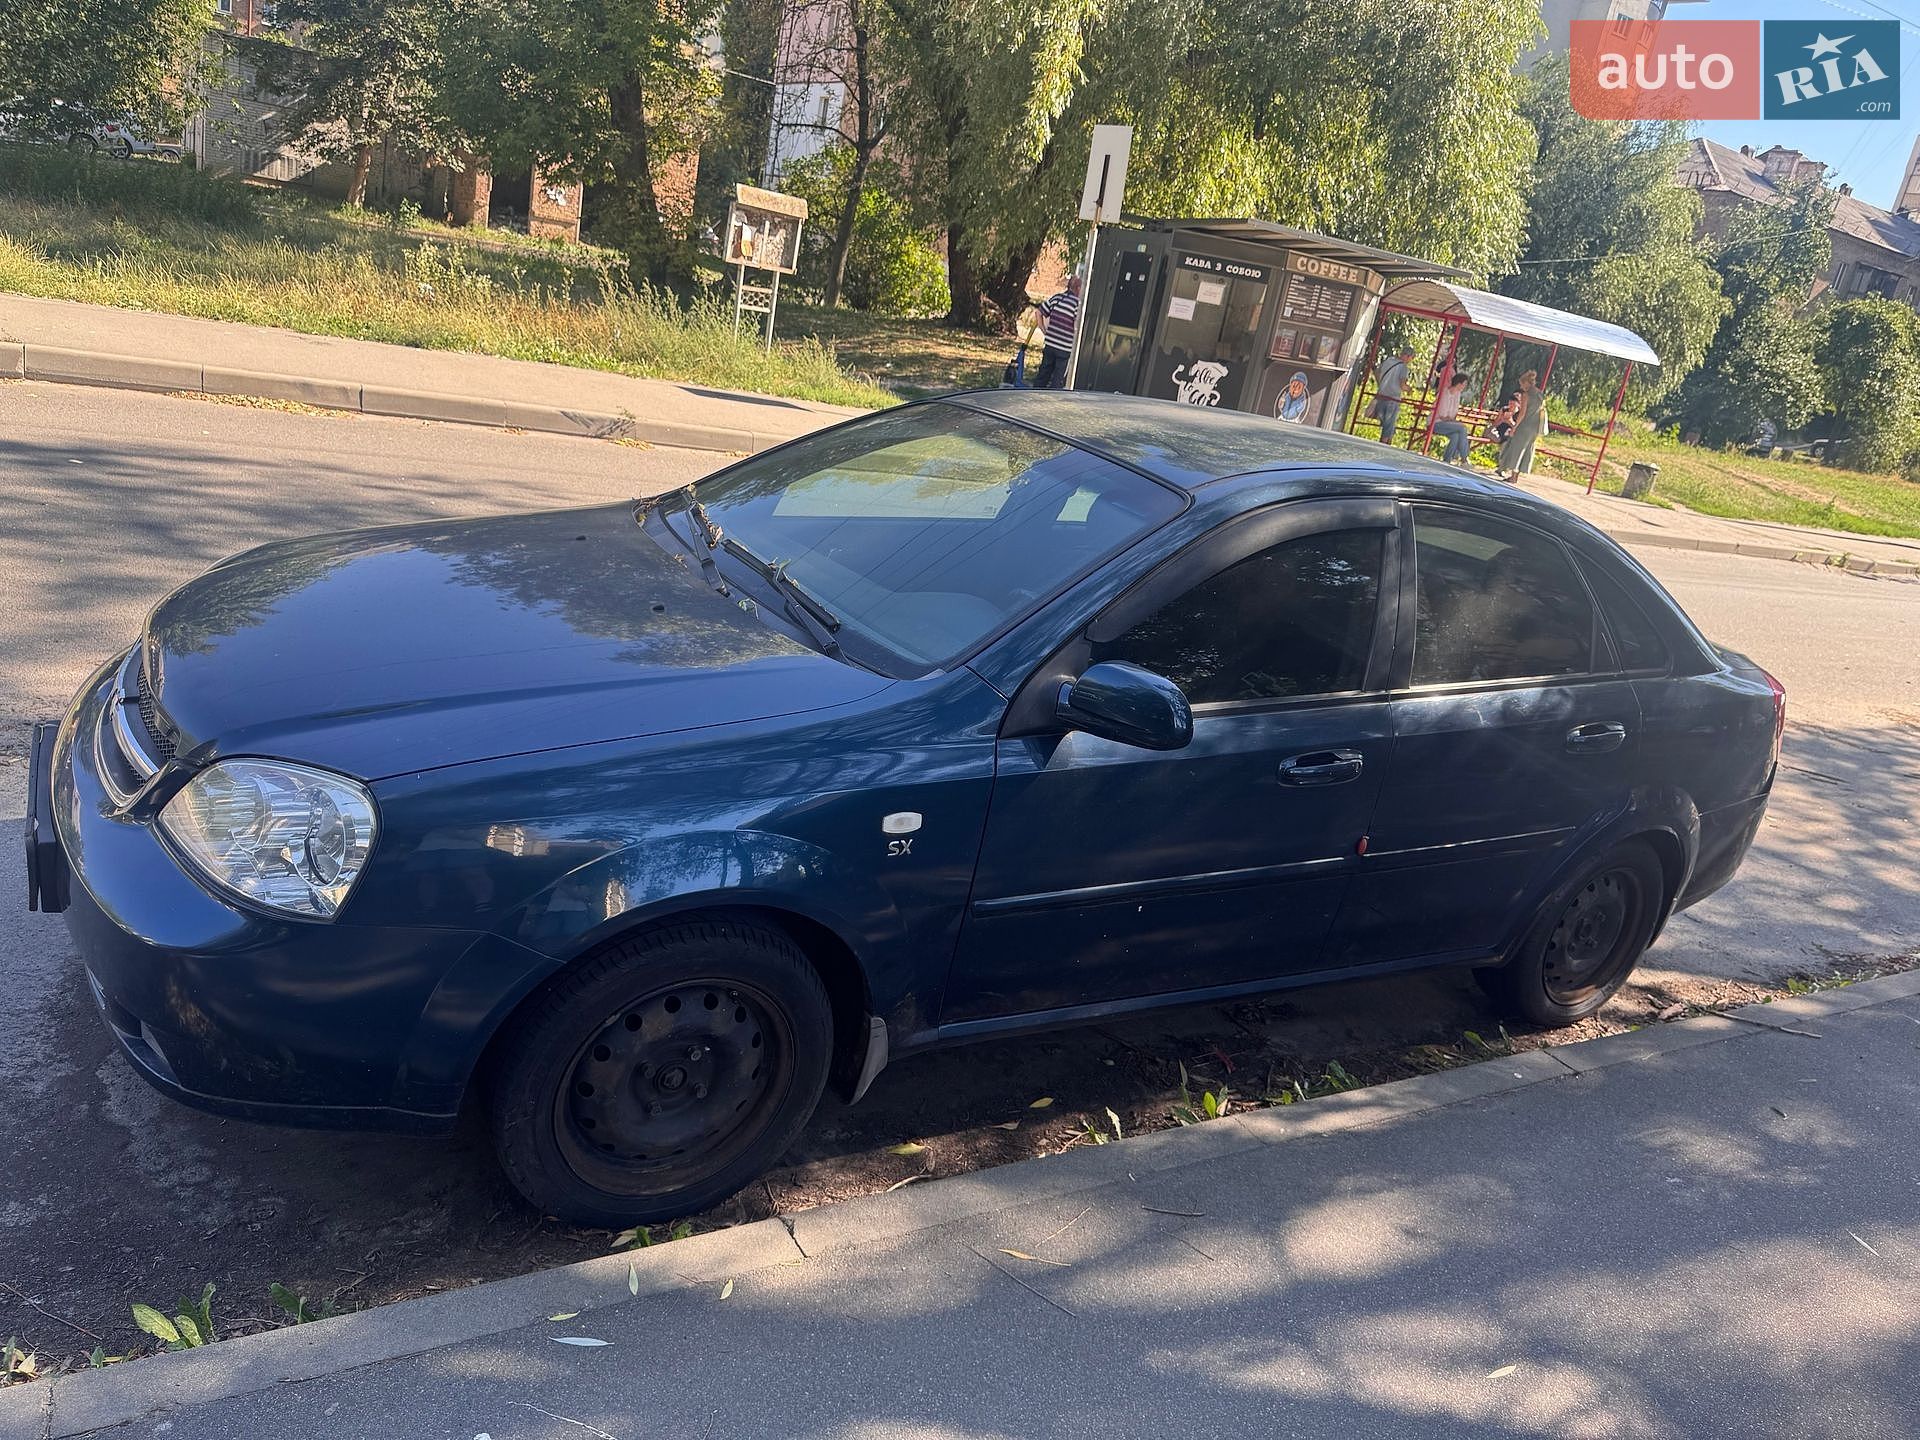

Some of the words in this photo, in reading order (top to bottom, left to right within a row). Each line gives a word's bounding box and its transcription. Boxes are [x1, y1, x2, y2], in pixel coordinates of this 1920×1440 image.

[1184, 256, 1212, 269] КАВА
[1225, 264, 1262, 279] СОБОЮ
[1296, 256, 1359, 282] COFFEE
[887, 839, 913, 857] SX
